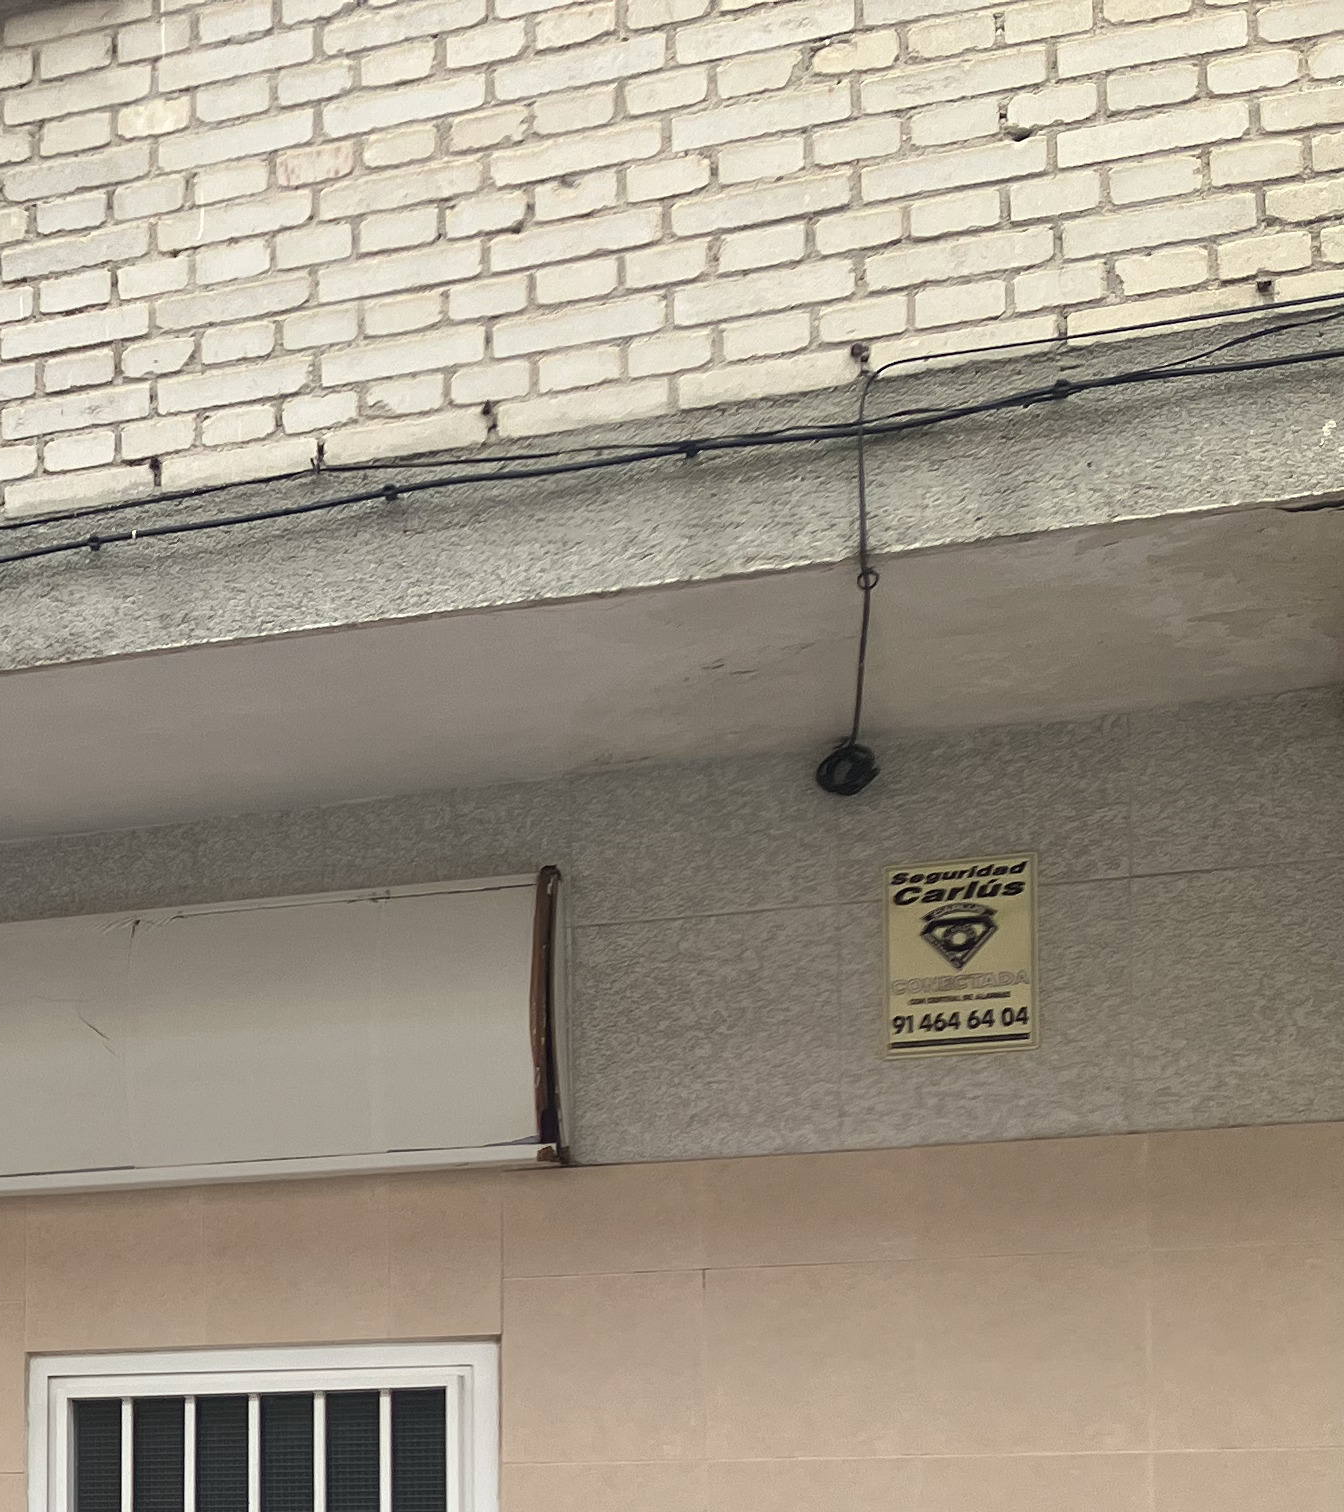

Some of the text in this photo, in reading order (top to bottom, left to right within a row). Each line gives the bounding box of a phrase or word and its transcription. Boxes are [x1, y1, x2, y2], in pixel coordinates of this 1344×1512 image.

[891, 861, 1028, 885] Seguridad
[894, 879, 1025, 905] Carlús
[892, 969, 1030, 995] CONECTADA
[892, 1006, 1029, 1034] 91 464 64 04
